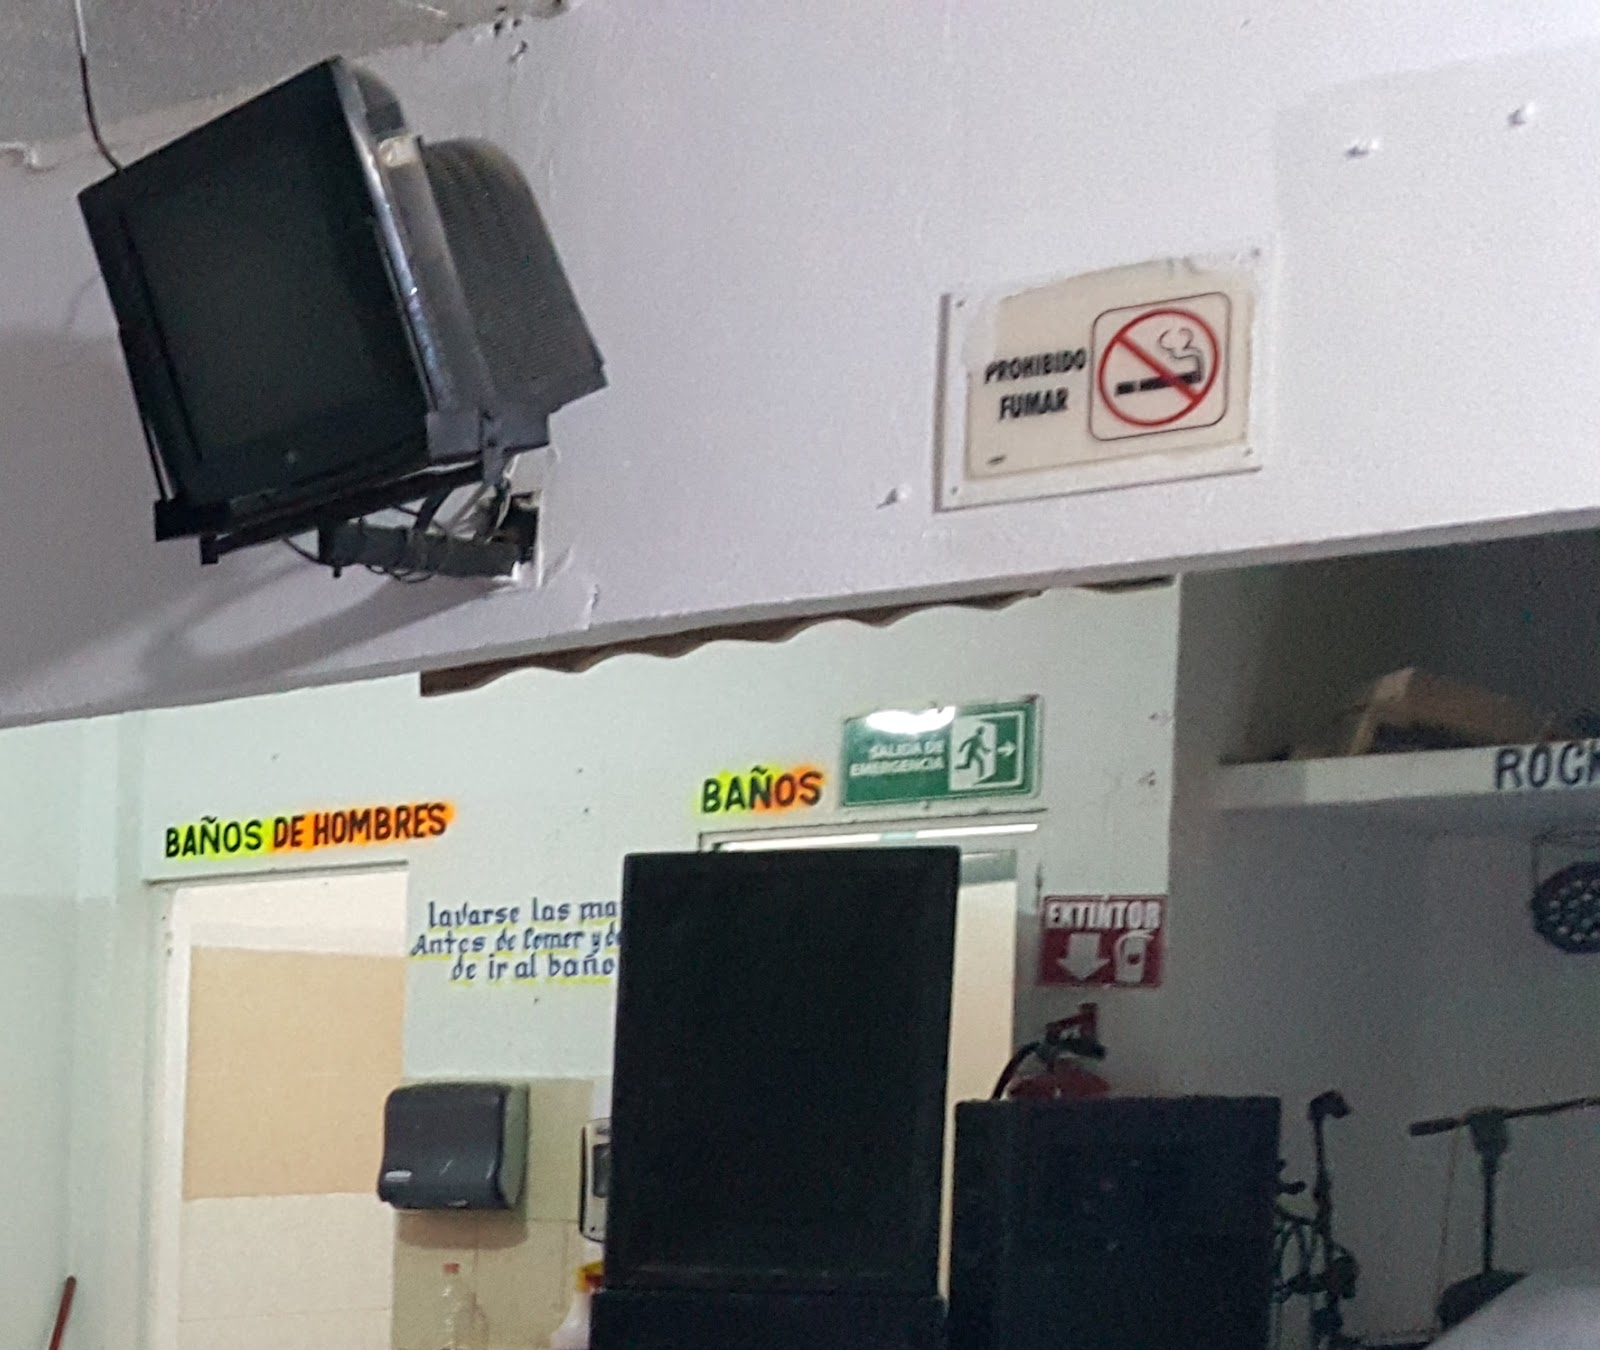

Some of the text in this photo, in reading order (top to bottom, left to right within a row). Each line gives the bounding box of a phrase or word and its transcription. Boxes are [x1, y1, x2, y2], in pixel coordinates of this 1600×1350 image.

[984, 346, 1087, 384] PROHIBIDO
[999, 387, 1068, 420] FUMAR
[701, 765, 824, 814] BAÑOS
[165, 802, 448, 858] BAÑOS DE HOMBRES
[580, 901, 617, 921] ma
[1047, 901, 1161, 930] EXTINTOR
[410, 930, 486, 956] Antes
[495, 927, 516, 951] de
[452, 956, 477, 980] de
[488, 953, 509, 979] ir
[549, 953, 615, 978] baño
